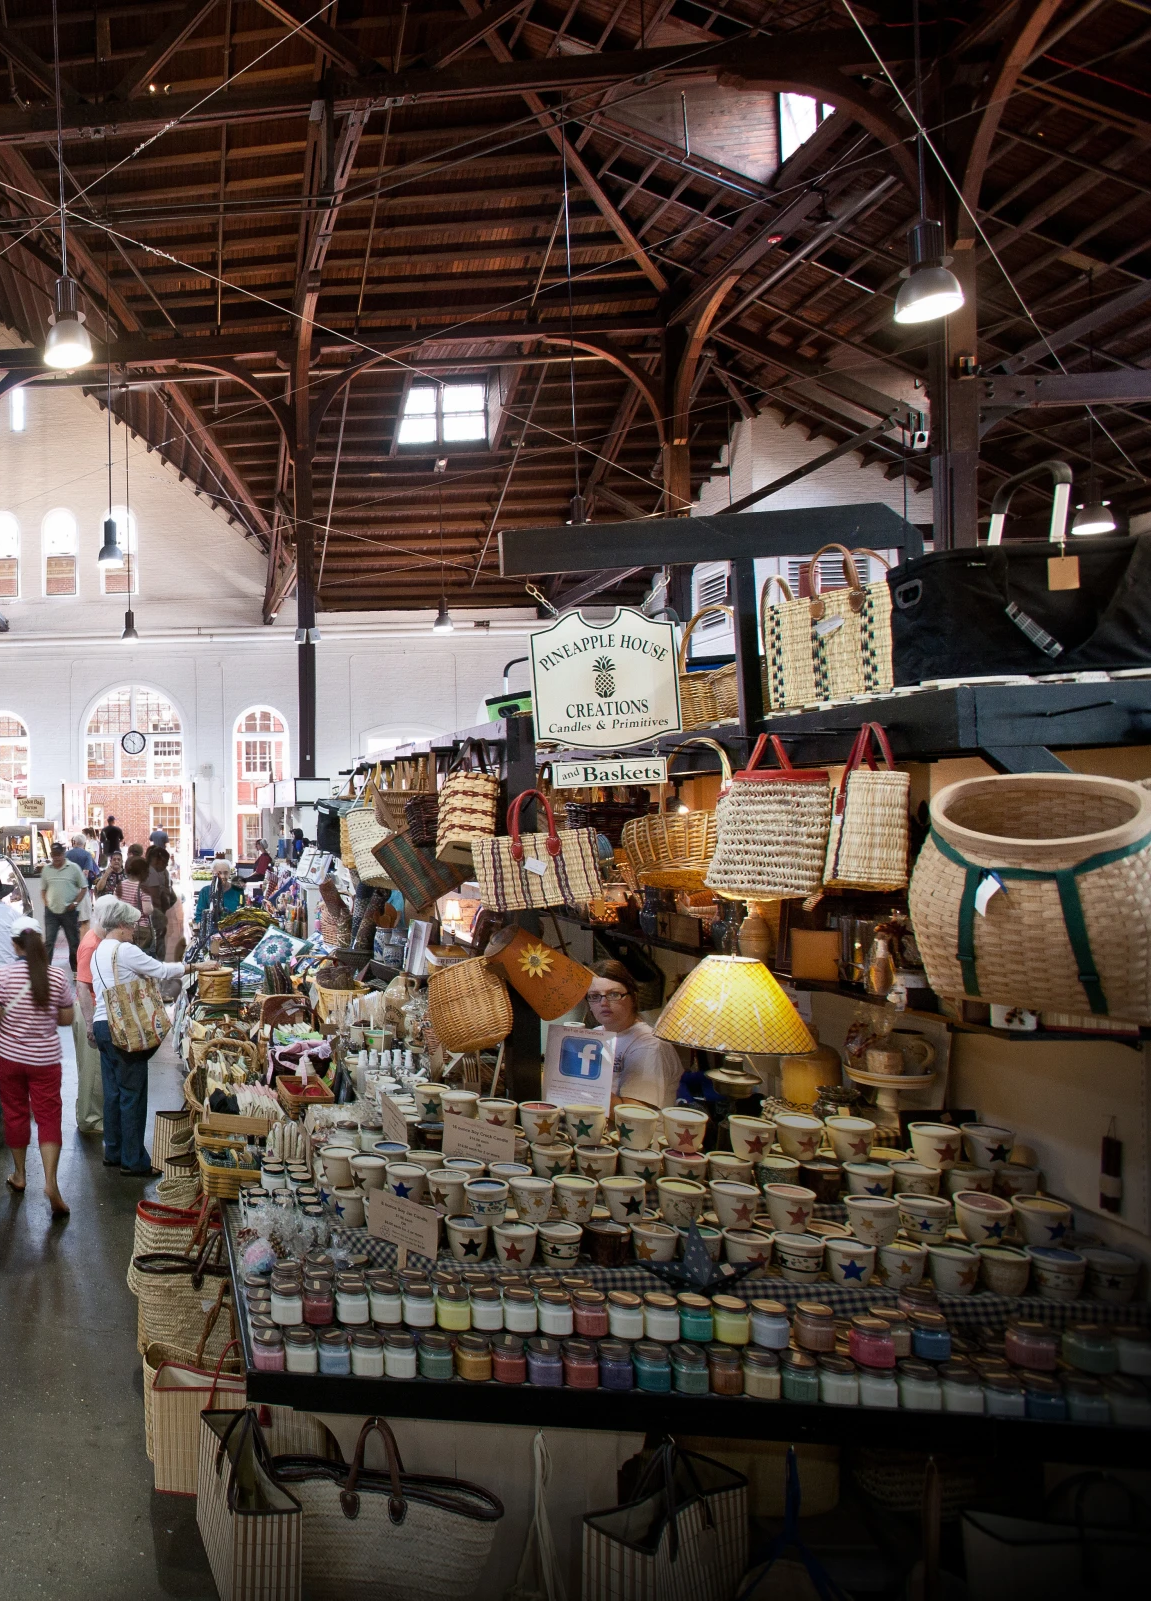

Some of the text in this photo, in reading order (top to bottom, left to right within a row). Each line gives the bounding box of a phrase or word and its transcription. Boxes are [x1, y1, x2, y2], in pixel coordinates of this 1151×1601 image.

[538, 633, 669, 672] PINEAPPLE HOUSE
[566, 699, 649, 719] CREATIONS
[549, 717, 669, 734] Candles & Primitives
[561, 764, 661, 783] and Baskets
[414, 1213, 428, 1223] Candle
